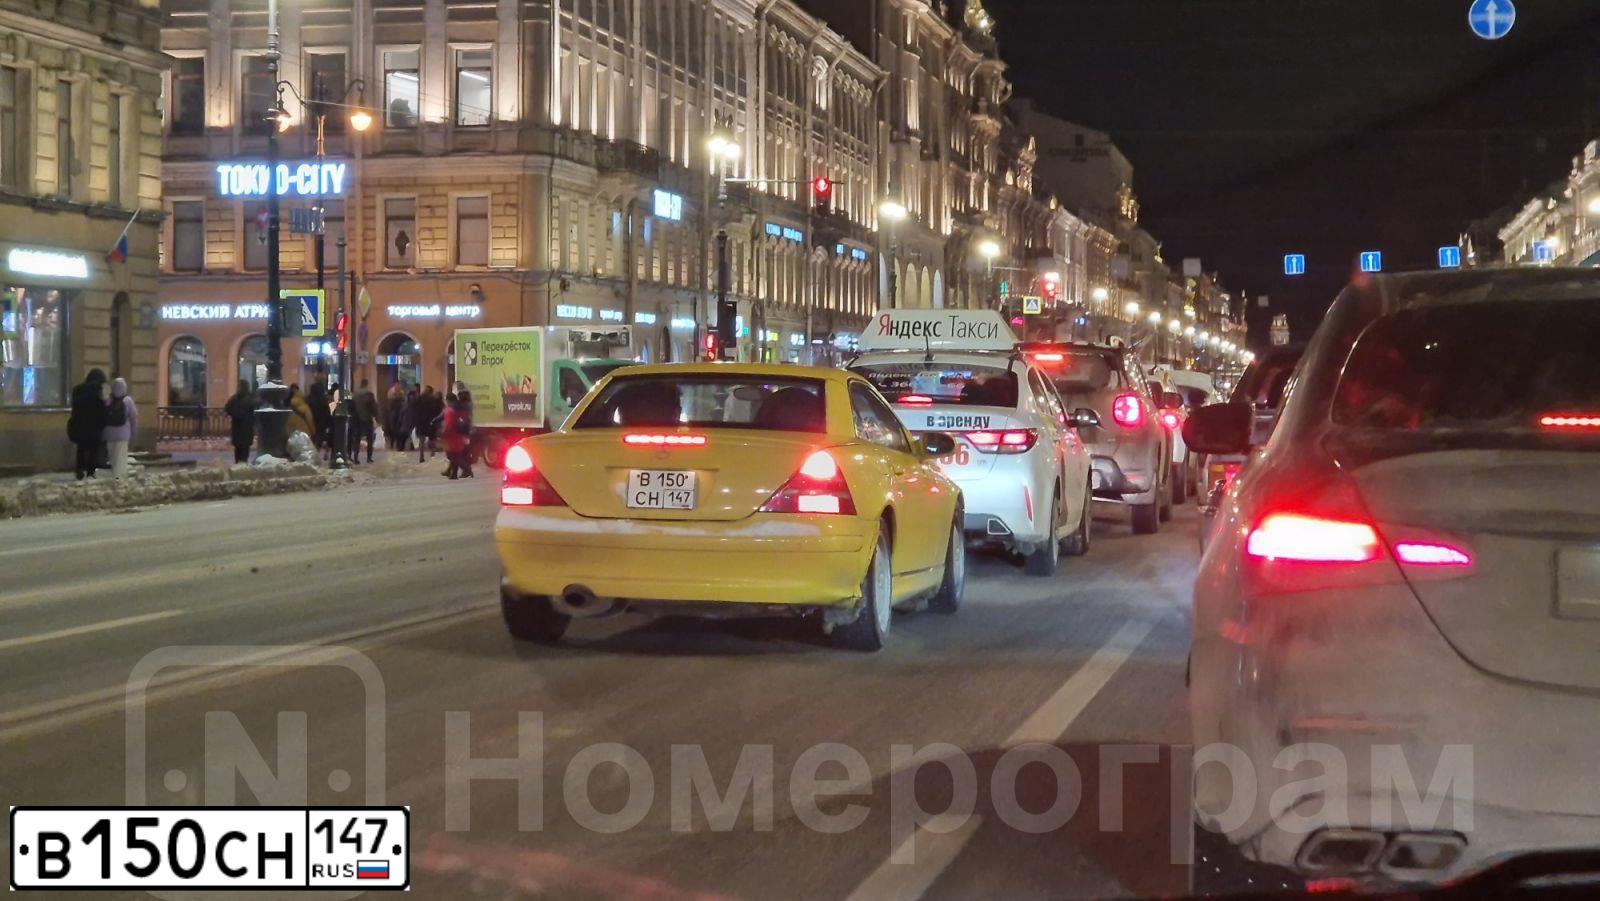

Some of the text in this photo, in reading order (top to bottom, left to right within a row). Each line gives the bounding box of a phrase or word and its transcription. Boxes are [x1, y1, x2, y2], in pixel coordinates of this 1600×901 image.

[162, 303, 230, 319] НЕВСКИЙ
[878, 314, 998, 338] Яндекс Такси
[481, 355, 505, 367] Впрок
[508, 401, 532, 413] vprok.ru
[926, 415, 990, 429] в аренду
[657, 472, 685, 487] 150
[636, 491, 691, 506] СН 147
